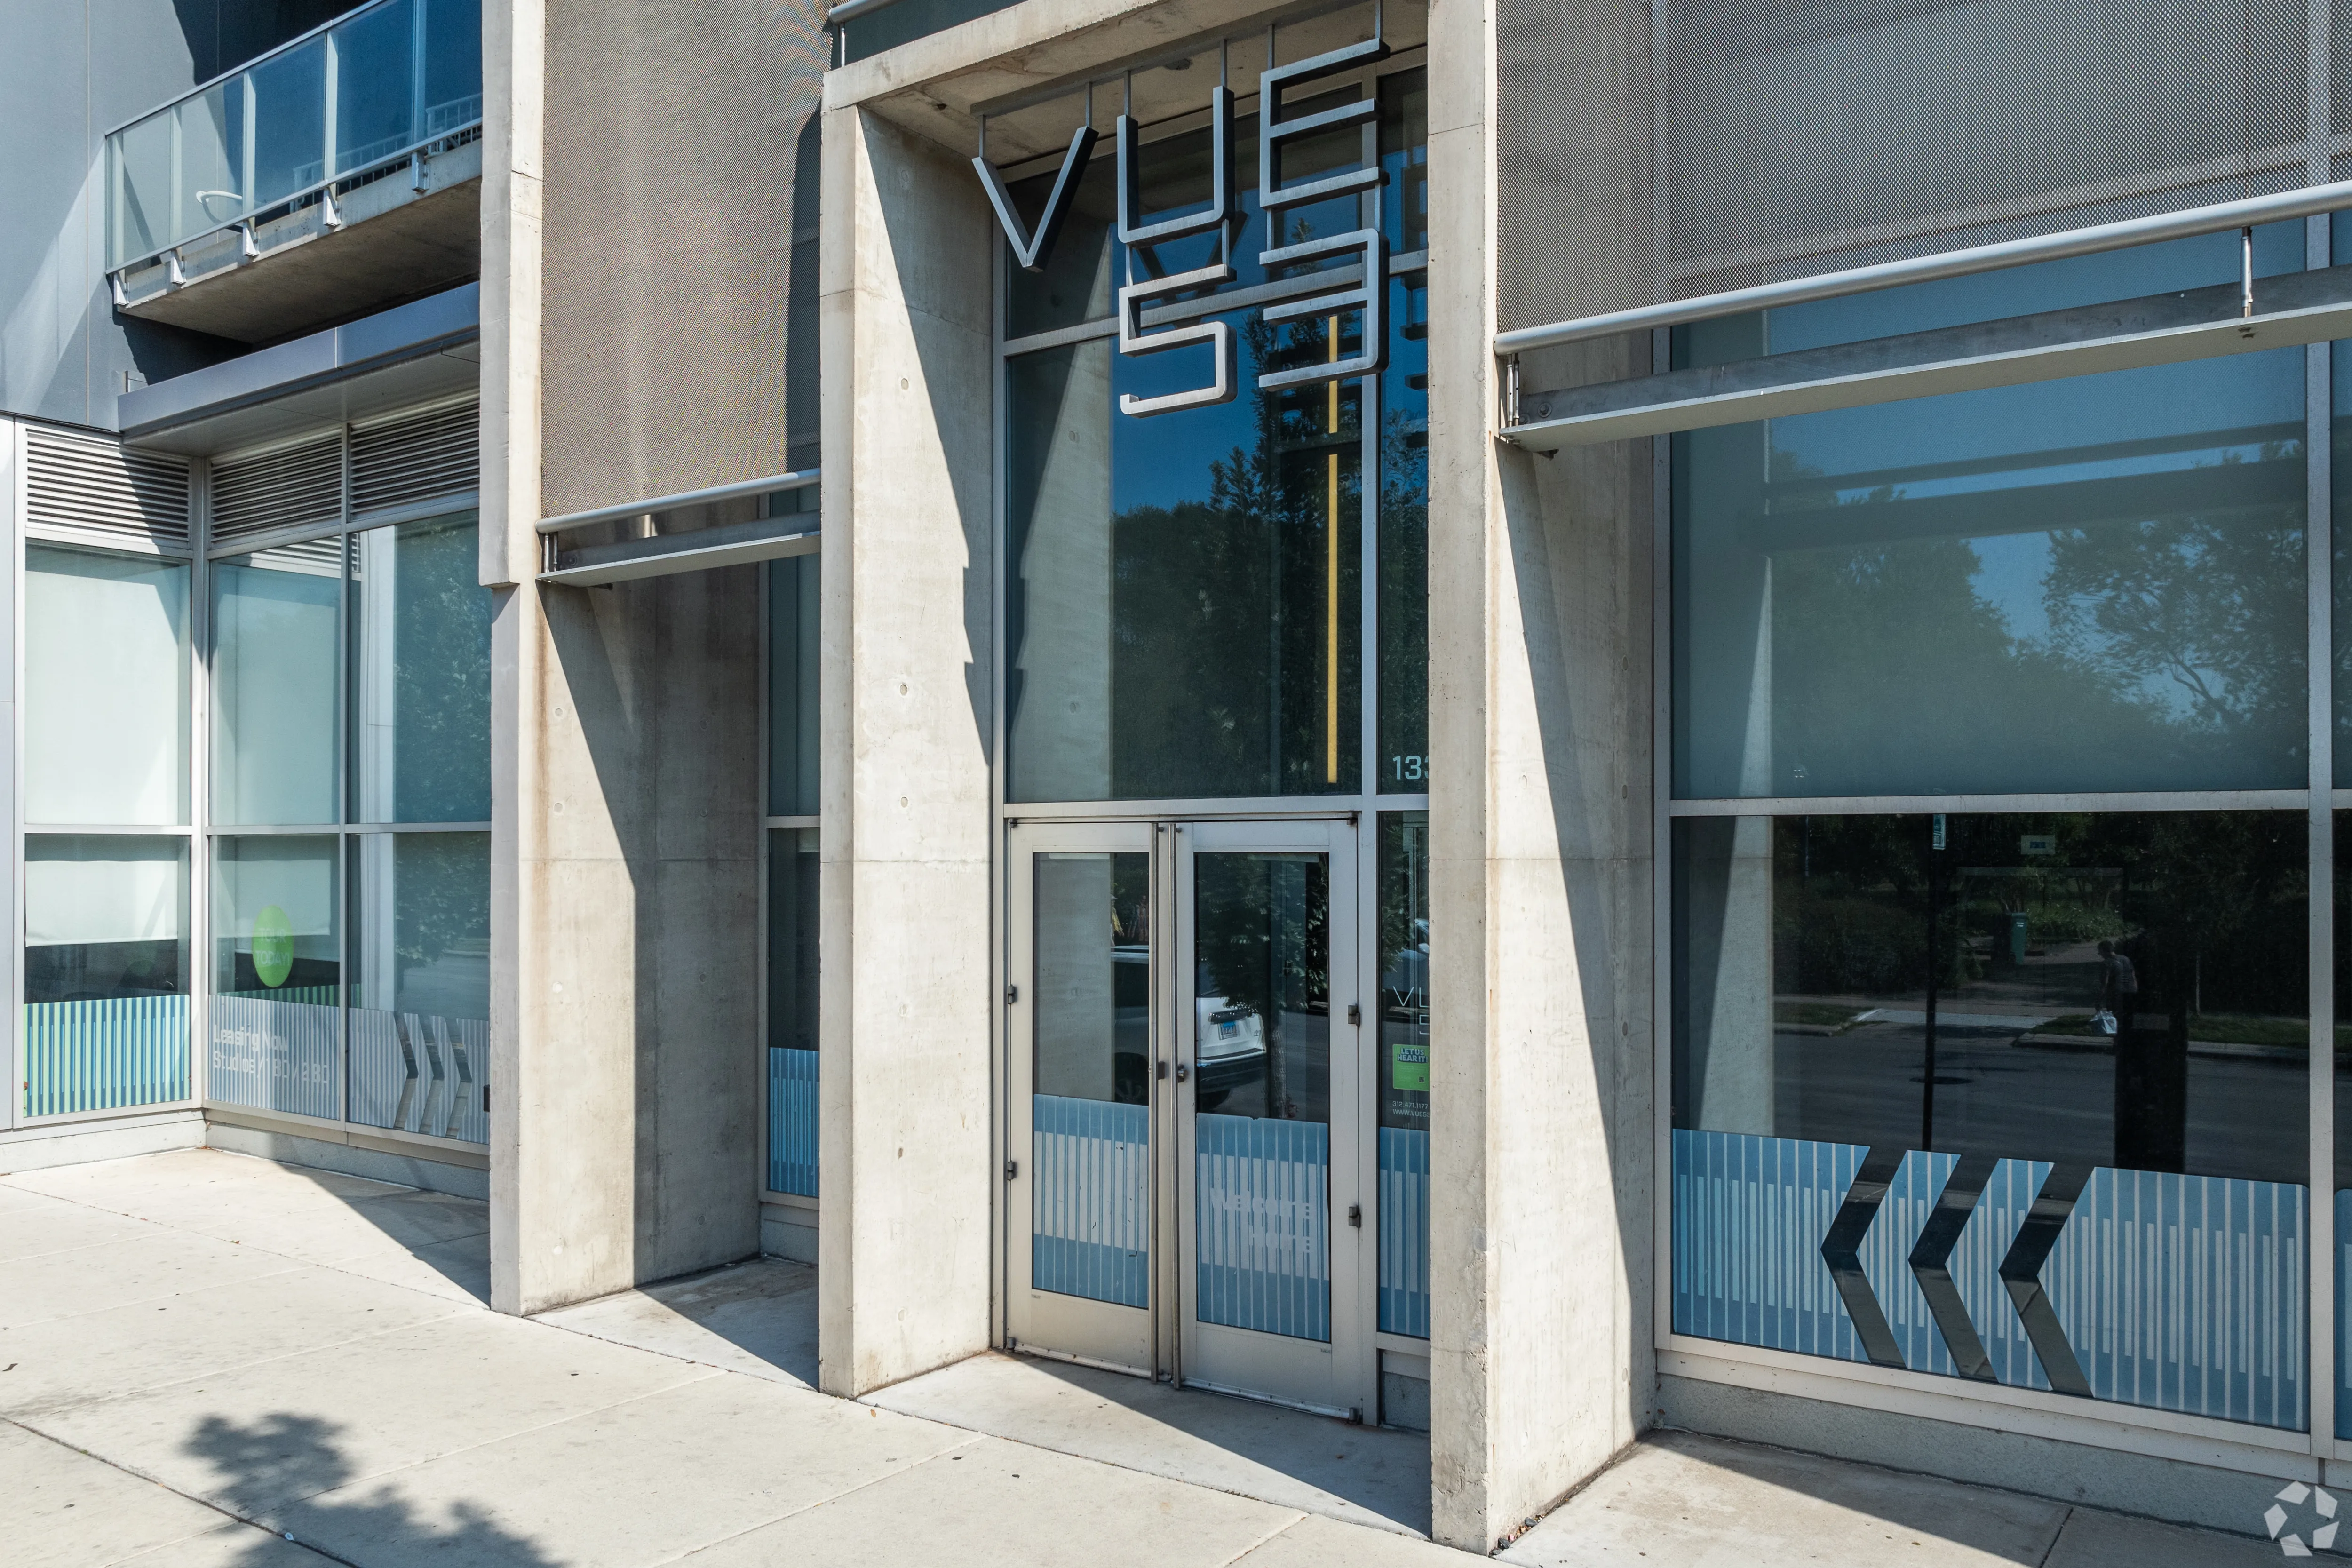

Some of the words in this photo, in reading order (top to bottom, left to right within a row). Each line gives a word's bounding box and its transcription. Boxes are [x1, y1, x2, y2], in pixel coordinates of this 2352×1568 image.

[972, 39, 1391, 272] VUE
[1118, 228, 1390, 418] 53
[258, 927, 286, 943] TOUR
[213, 1024, 259, 1051] Leasing
[262, 1030, 289, 1051] Now
[213, 1051, 254, 1074] Studios
[1392, 1101, 1429, 1109] 312.471.1177
[1210, 1187, 1312, 1219] Welcome
[1248, 1225, 1311, 1253] Home
